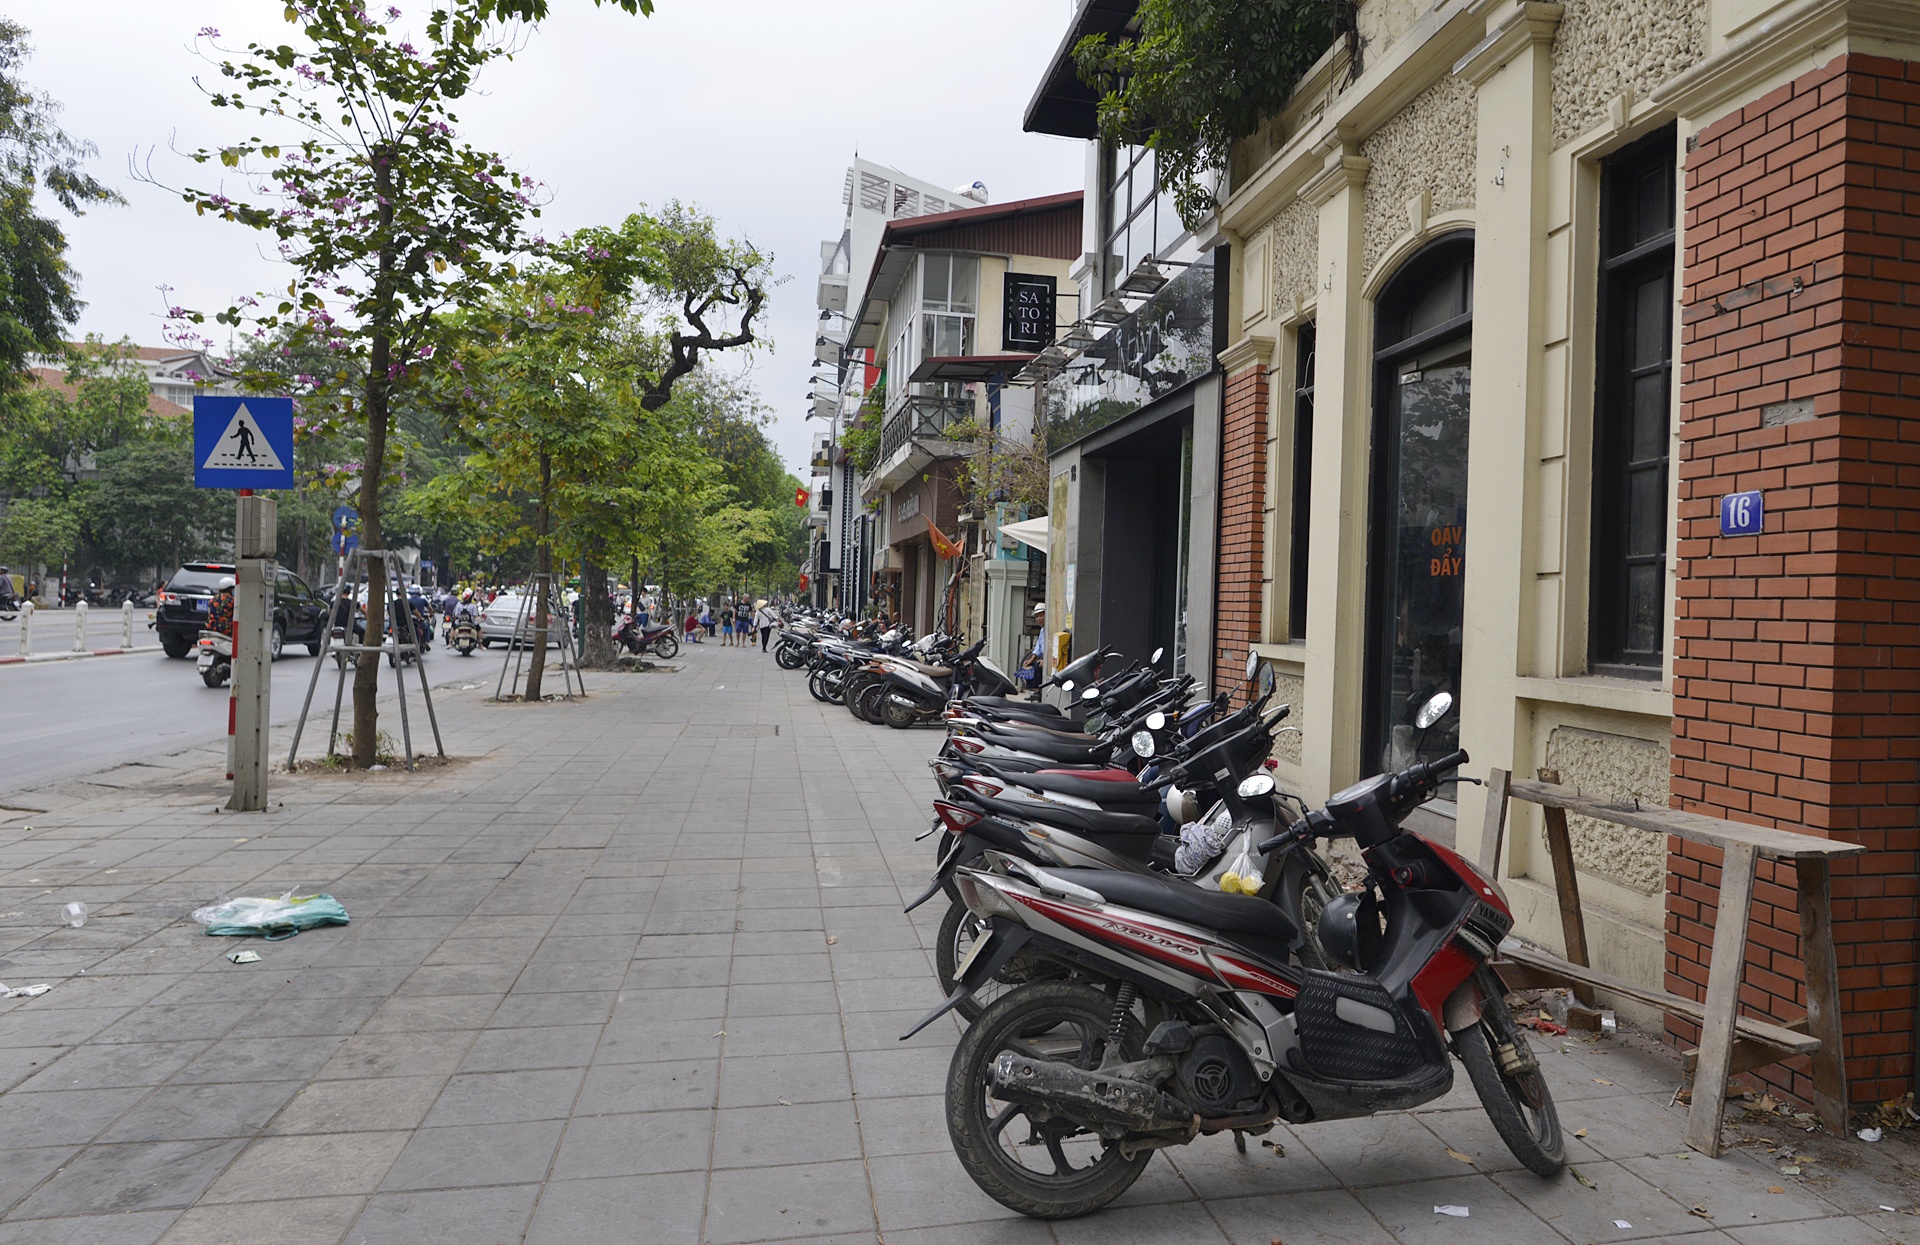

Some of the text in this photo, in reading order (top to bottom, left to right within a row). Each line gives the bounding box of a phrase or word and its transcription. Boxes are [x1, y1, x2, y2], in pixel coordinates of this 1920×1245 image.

[1019, 291, 1039, 304] SA
[1018, 306, 1040, 320] TO
[1020, 321, 1038, 334] RI
[1729, 496, 1751, 529] 16
[1430, 548, 1462, 576] ĐẨY
[1479, 904, 1508, 930] YAMAHA
